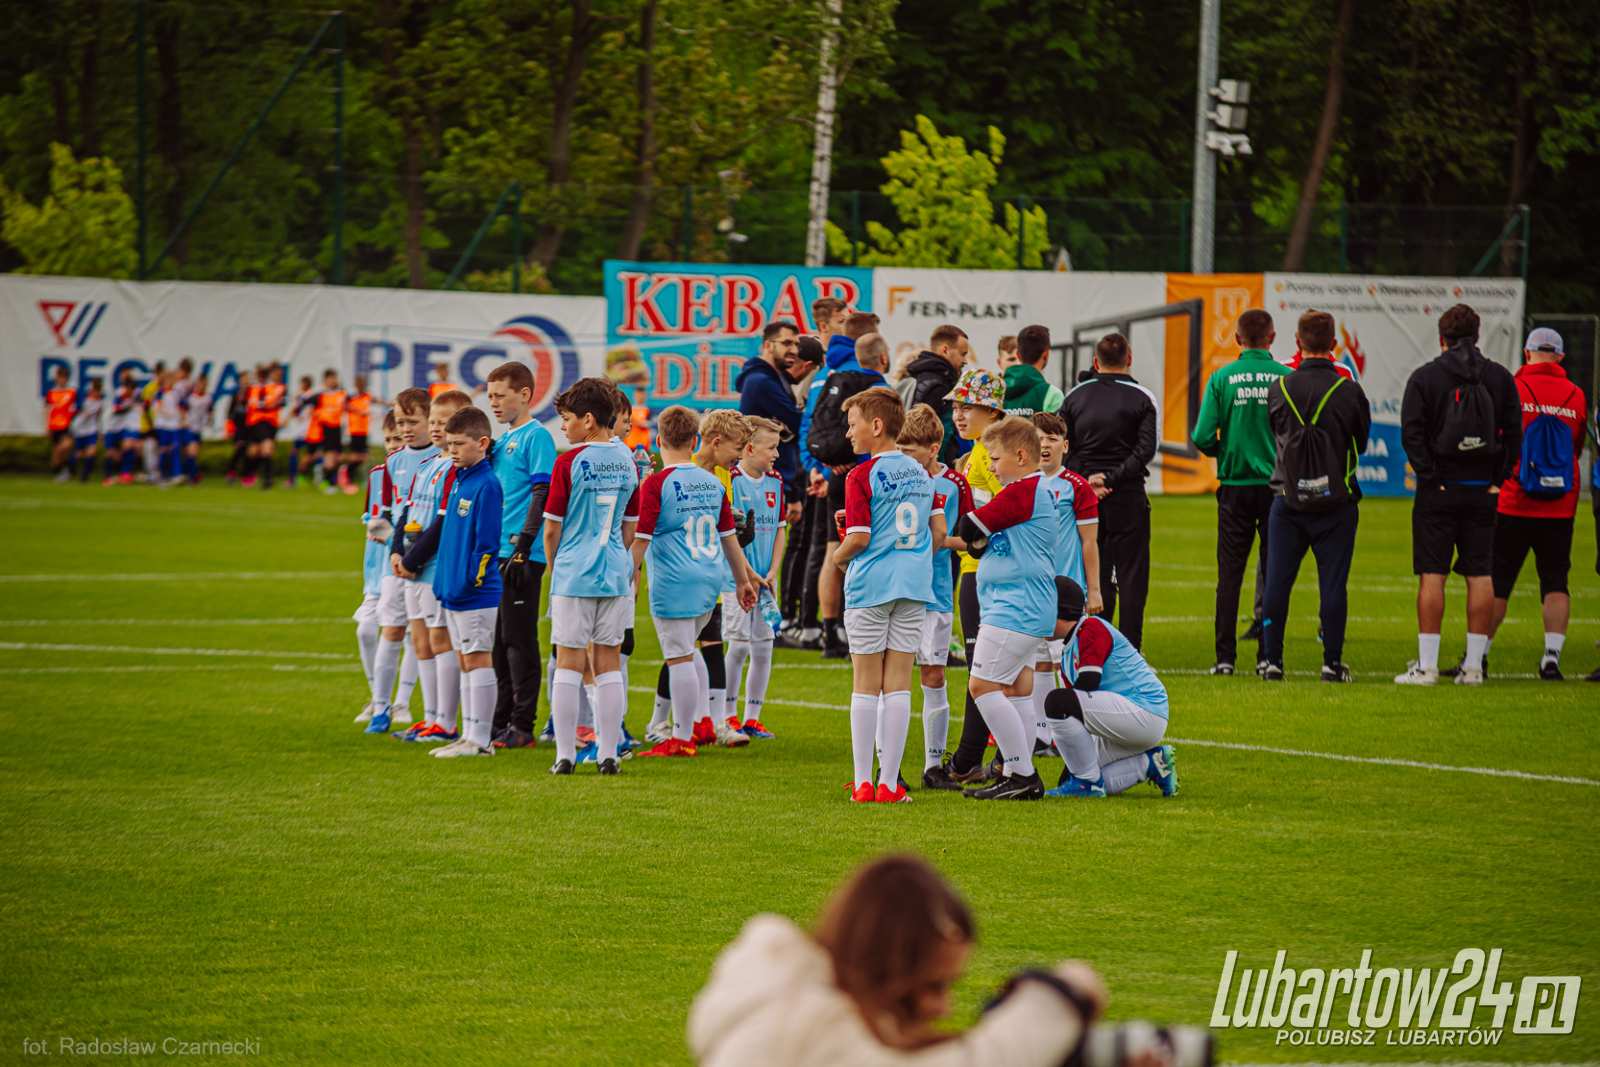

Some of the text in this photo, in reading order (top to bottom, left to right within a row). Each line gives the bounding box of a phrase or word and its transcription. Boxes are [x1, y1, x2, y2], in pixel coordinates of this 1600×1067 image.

[909, 301, 1021, 319] FER-PLAST
[1228, 372, 1253, 385] MKS
[595, 495, 618, 548] 7
[683, 514, 719, 558] 10
[895, 501, 918, 550] 9
